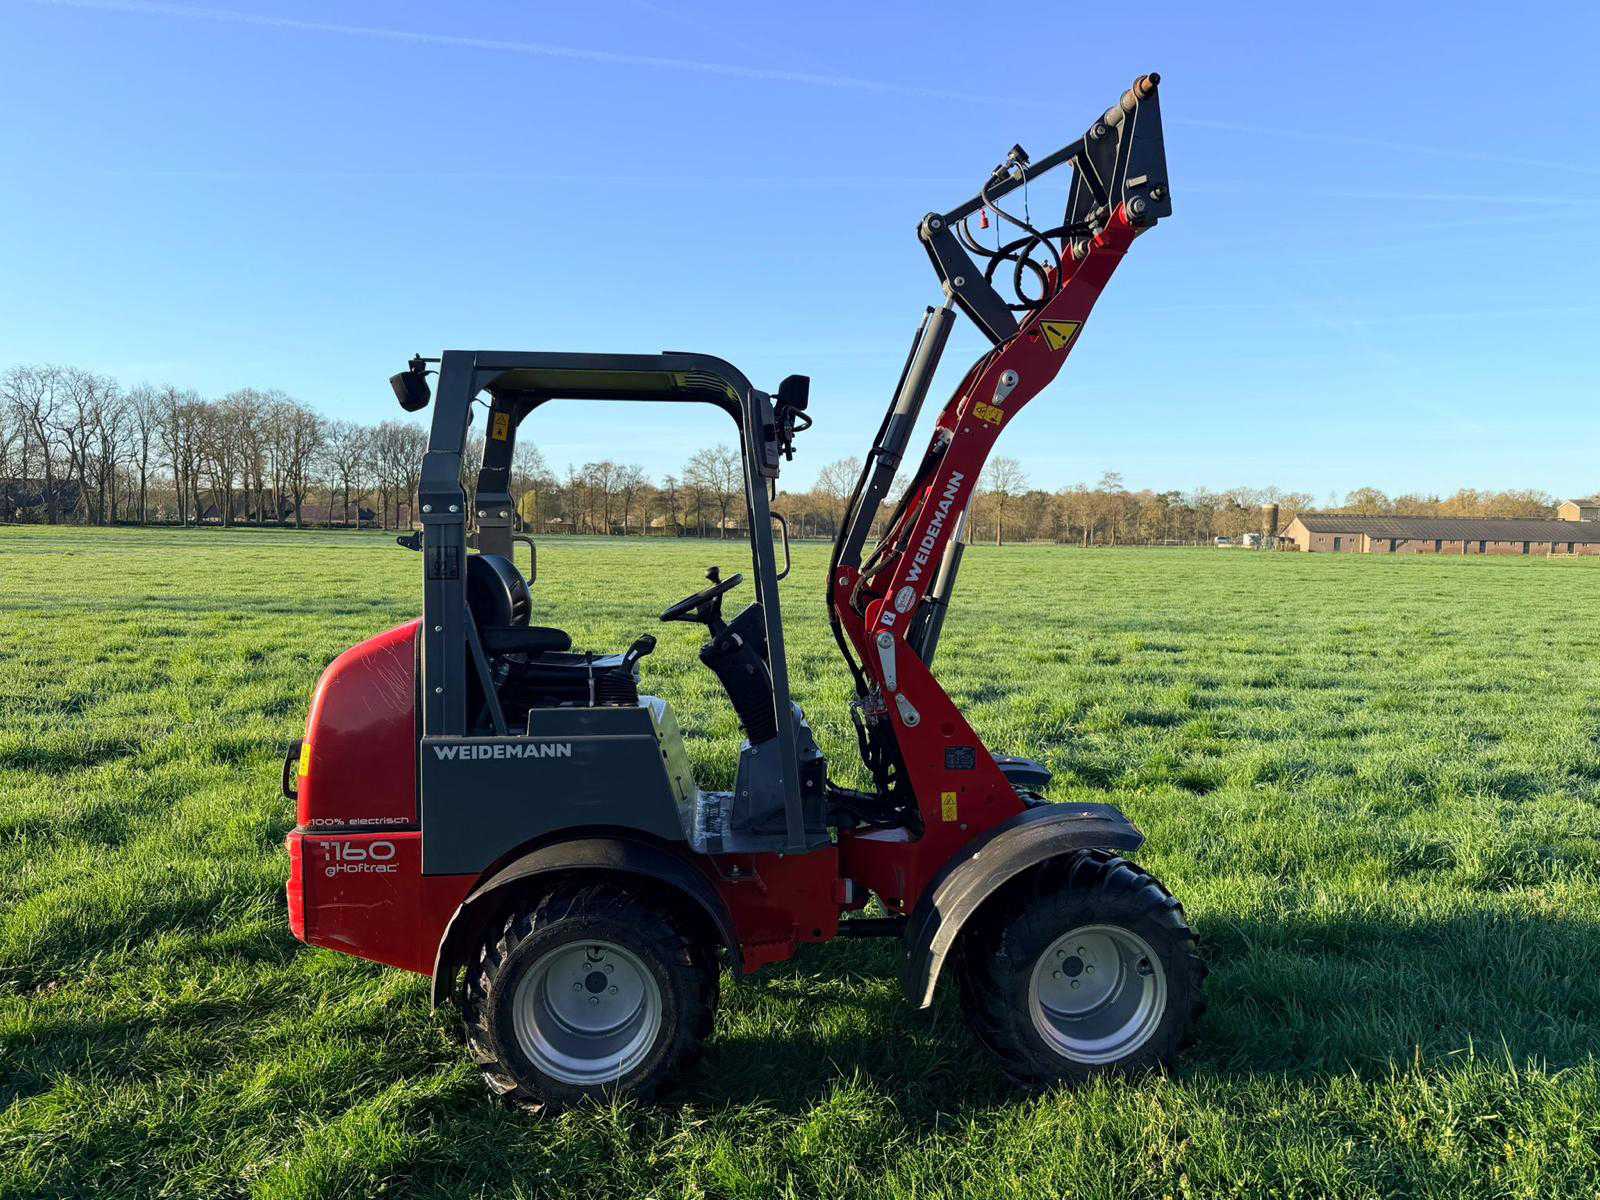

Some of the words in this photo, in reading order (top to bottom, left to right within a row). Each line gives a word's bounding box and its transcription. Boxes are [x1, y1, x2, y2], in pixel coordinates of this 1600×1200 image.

[905, 470, 965, 582] WEIDEMANN
[433, 743, 572, 760] WEIDEMANN
[311, 818, 345, 826] 100%
[349, 816, 410, 826] electrisch
[320, 840, 396, 861] 1160
